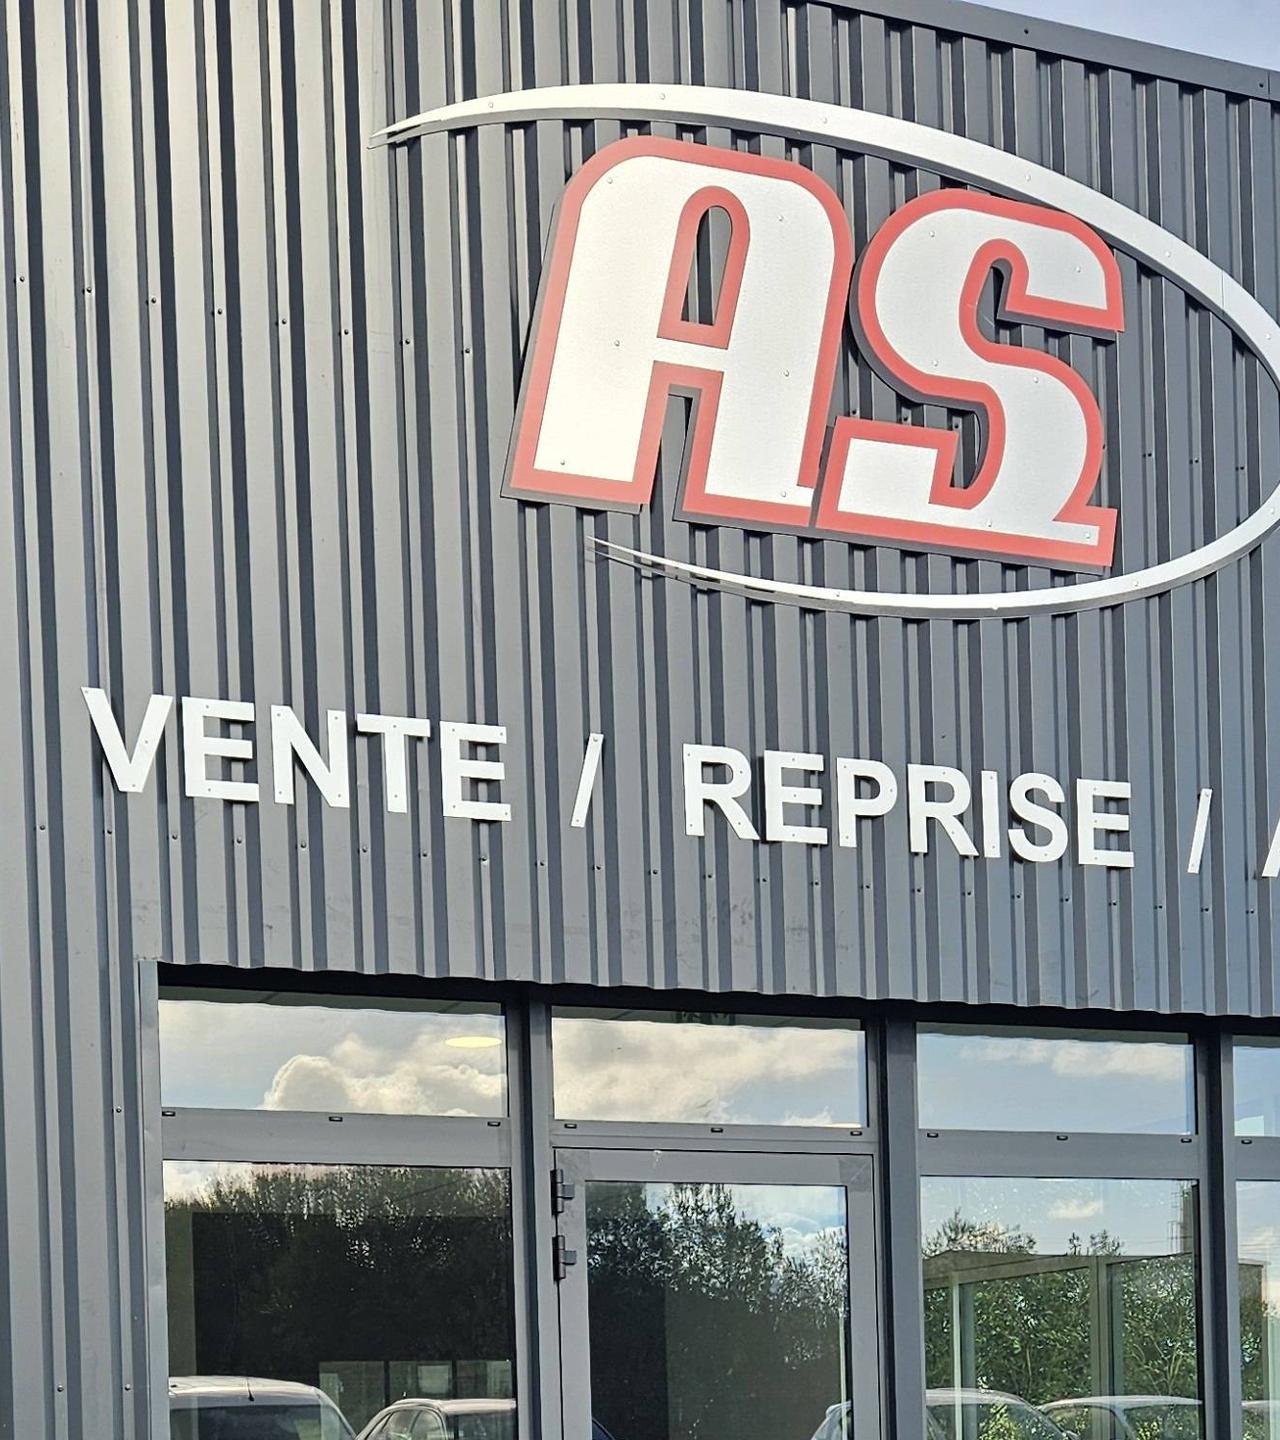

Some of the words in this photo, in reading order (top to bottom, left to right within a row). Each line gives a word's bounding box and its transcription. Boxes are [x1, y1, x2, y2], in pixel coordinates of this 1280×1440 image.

[505, 134, 1125, 570] AS
[81, 687, 511, 822] VENTE
[682, 743, 1135, 868] REPRISE
